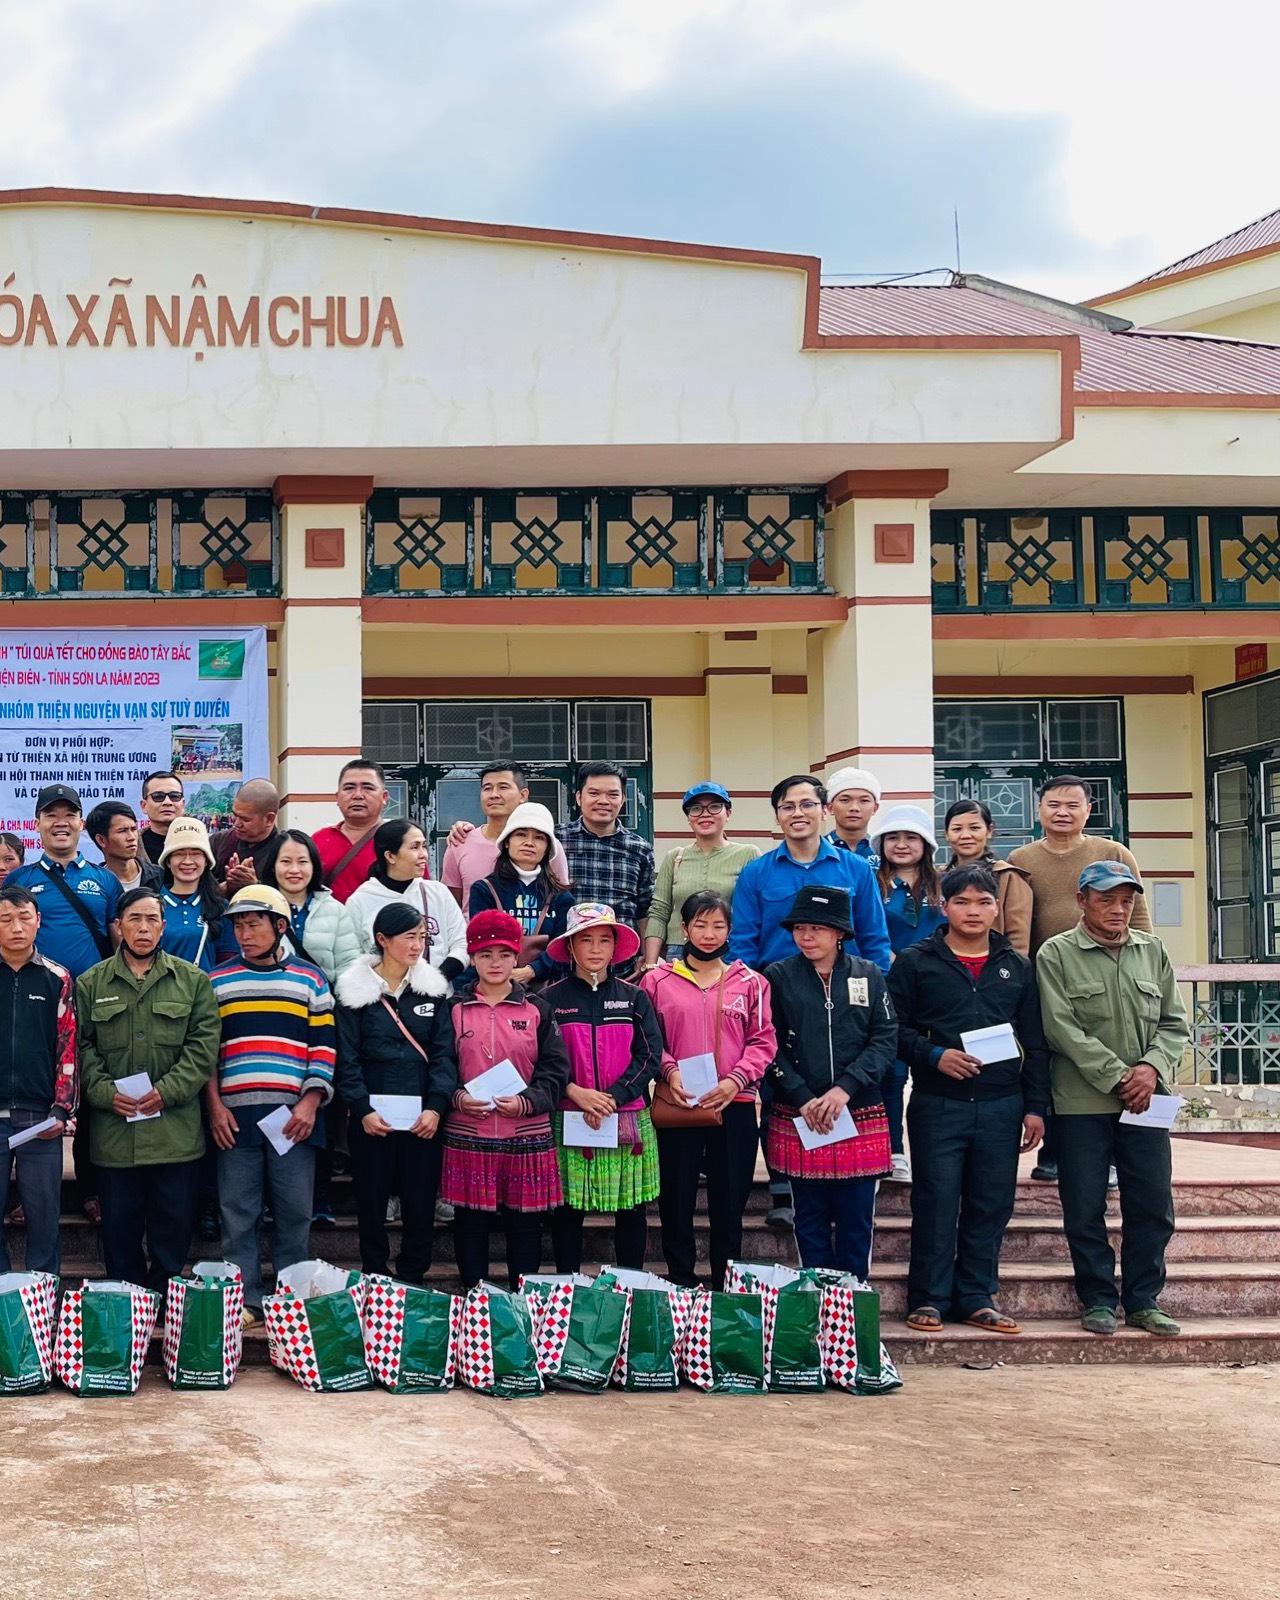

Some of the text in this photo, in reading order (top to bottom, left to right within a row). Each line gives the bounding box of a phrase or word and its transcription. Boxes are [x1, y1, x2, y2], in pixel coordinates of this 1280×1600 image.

[67, 276, 150, 348] XÃ
[146, 272, 260, 362] NẬM
[268, 294, 405, 348] CHUA
[15, 642, 31, 660] TÚI
[33, 643, 54, 661] QUÀ
[56, 641, 75, 660] TẾT
[76, 646, 97, 660] CHO
[98, 641, 126, 660] ĐỒNG
[128, 643, 149, 661] BÀO
[151, 643, 169, 661] TÂY
[171, 641, 191, 661] BẮC
[17, 668, 40, 685] BIÊN
[72, 670, 94, 686] SƠN
[96, 671, 108, 686] LA
[110, 669, 133, 686] NĂM
[134, 672, 160, 686] 2023
[0, 699, 34, 719] NHÓM
[37, 700, 71, 723] THIỆN
[74, 699, 121, 722] NGUYỆN
[124, 702, 148, 722] VẠN
[151, 700, 168, 721] SỰ
[194, 698, 230, 718] DUYÊN
[25, 736, 47, 747] ĐƠN
[50, 737, 59, 750] VỊ
[62, 733, 87, 747] PHỐI
[6, 751, 20, 763] TỪ
[21, 751, 52, 766] THIỆN
[54, 751, 69, 763] XÃ
[71, 751, 89, 766] HỘI
[91, 753, 126, 763] TRUNG
[128, 751, 157, 763] ƯƠNG
[9, 768, 27, 783] HỘI
[30, 770, 64, 781] THANH
[67, 769, 92, 781] NIÊN
[94, 769, 125, 783] THIỆN
[126, 768, 150, 781] TÂM
[14, 785, 28, 798] VÀ
[102, 785, 125, 798] TÂM
